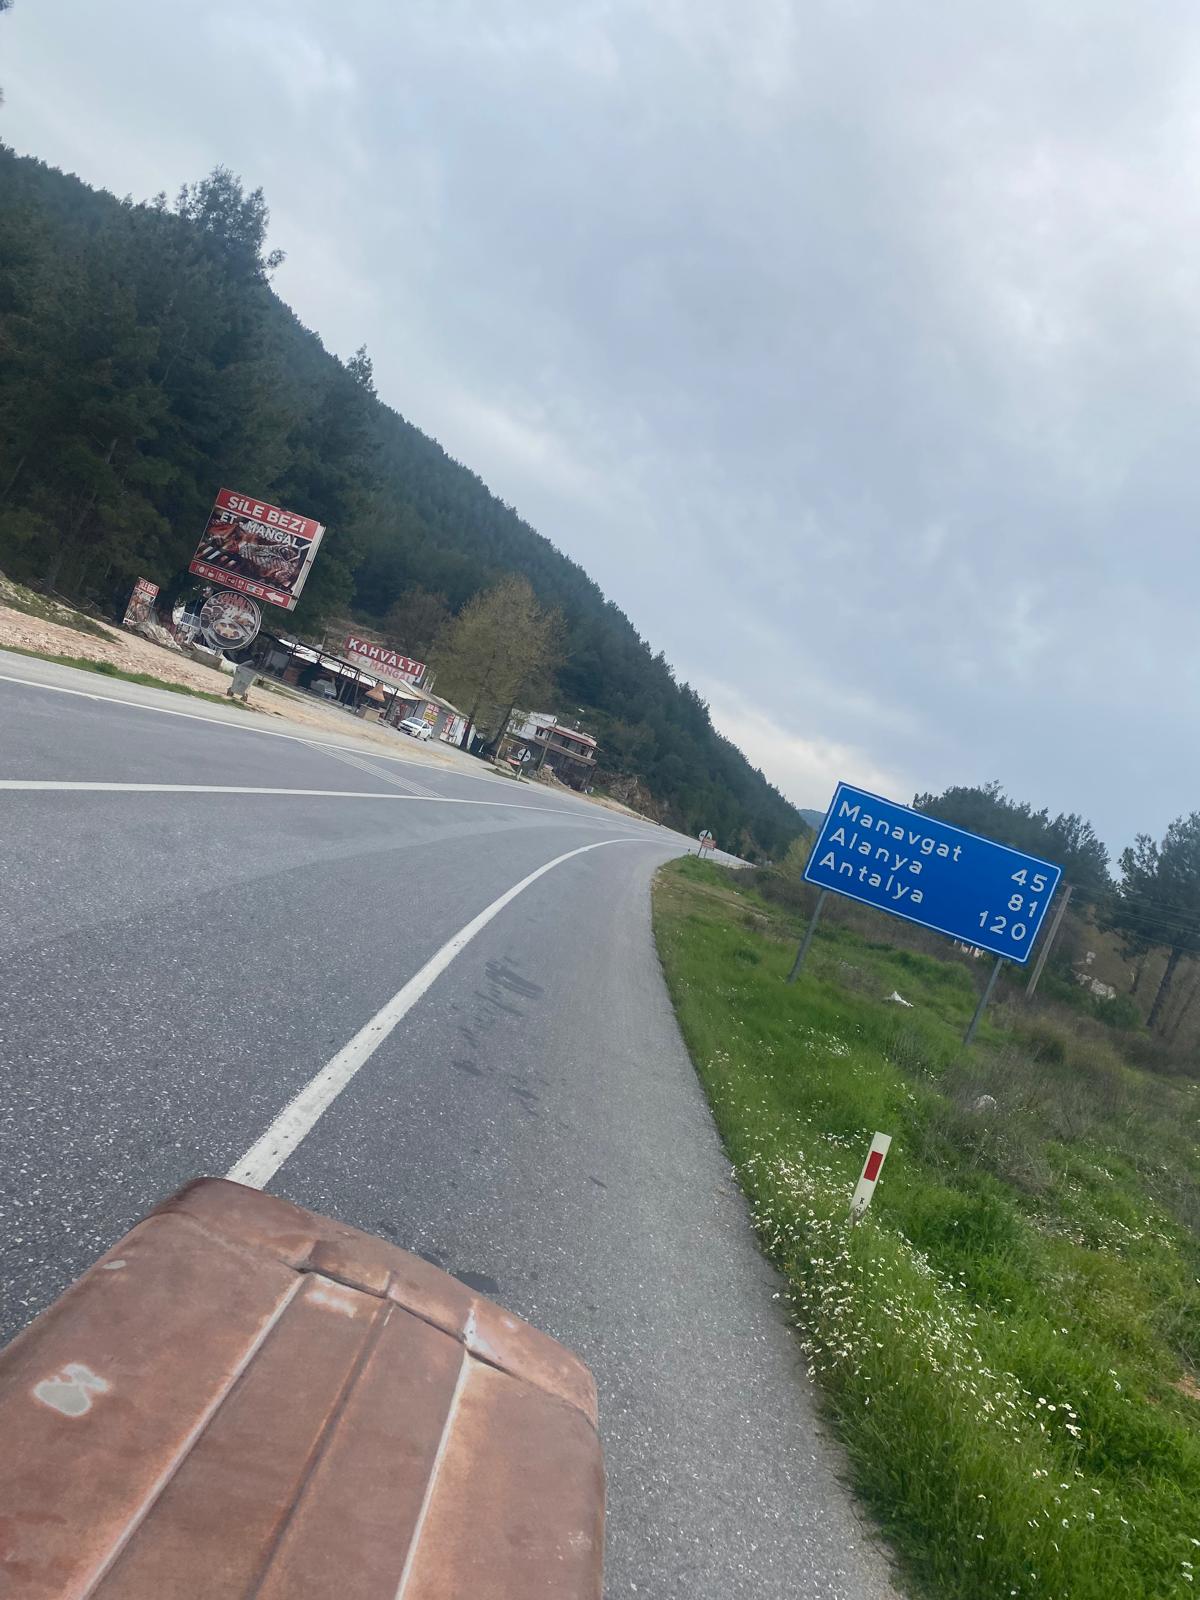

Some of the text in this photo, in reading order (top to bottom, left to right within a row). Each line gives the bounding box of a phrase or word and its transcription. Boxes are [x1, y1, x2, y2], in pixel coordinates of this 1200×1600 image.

[220, 511, 237, 525] ET
[245, 520, 299, 547] MANGAL
[267, 510, 306, 533] BEZİ
[348, 638, 421, 675] KAHVALTI
[829, 827, 1039, 918] Alanya 81
[838, 801, 1048, 893] Manavgat 45
[819, 851, 1027, 941] Antalya 120
